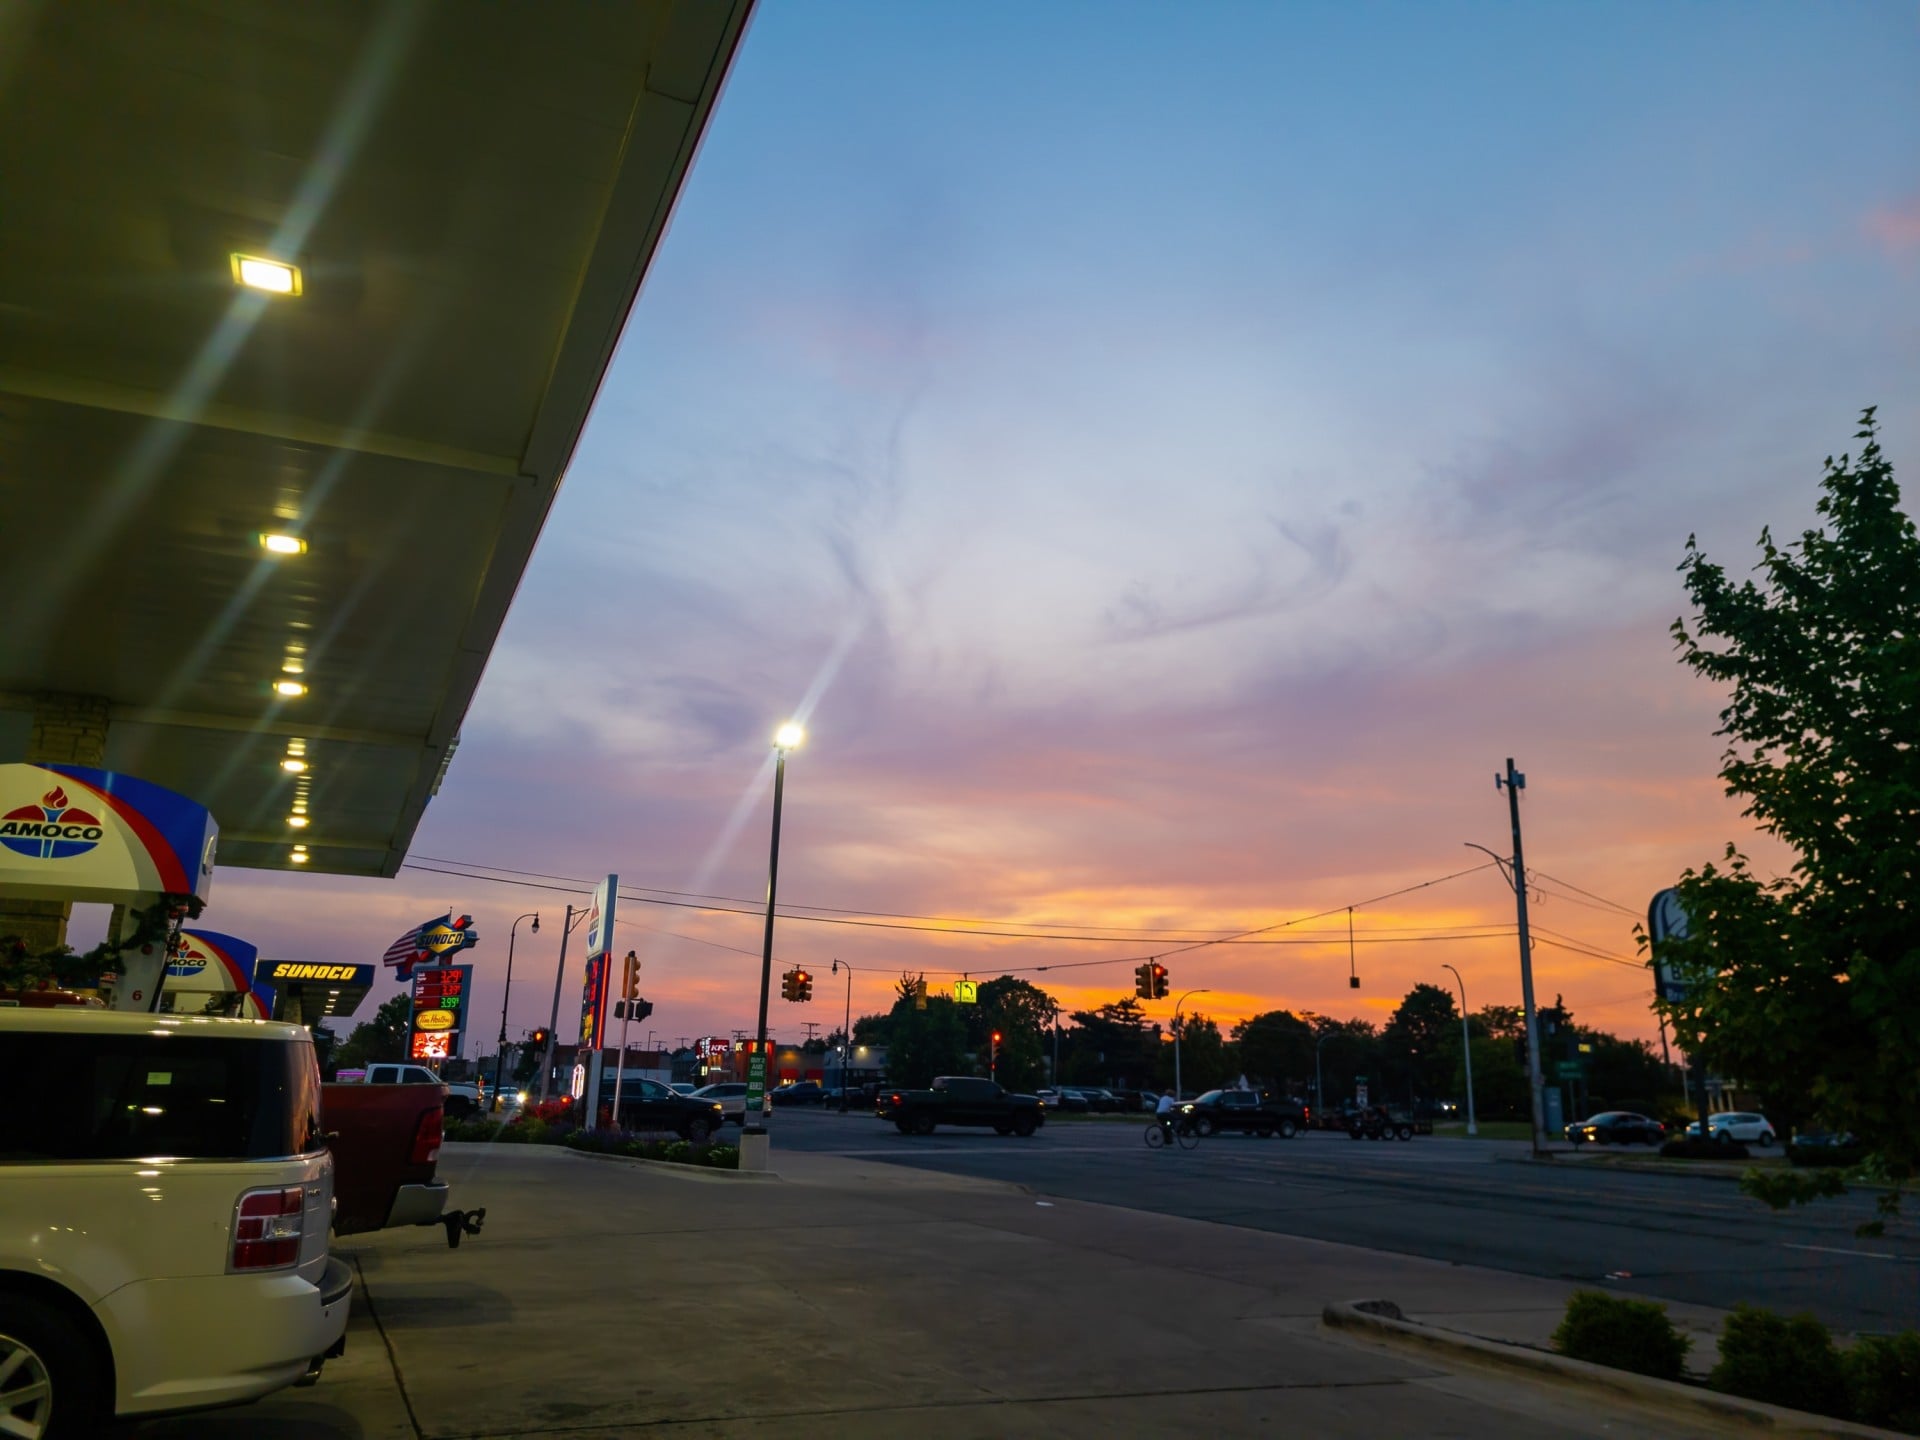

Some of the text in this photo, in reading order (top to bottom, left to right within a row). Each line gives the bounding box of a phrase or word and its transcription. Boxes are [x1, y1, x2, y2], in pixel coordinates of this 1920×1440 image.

[0, 822, 103, 840] AMOCO
[273, 963, 357, 980] SUNOCO
[132, 990, 142, 1002] 6
